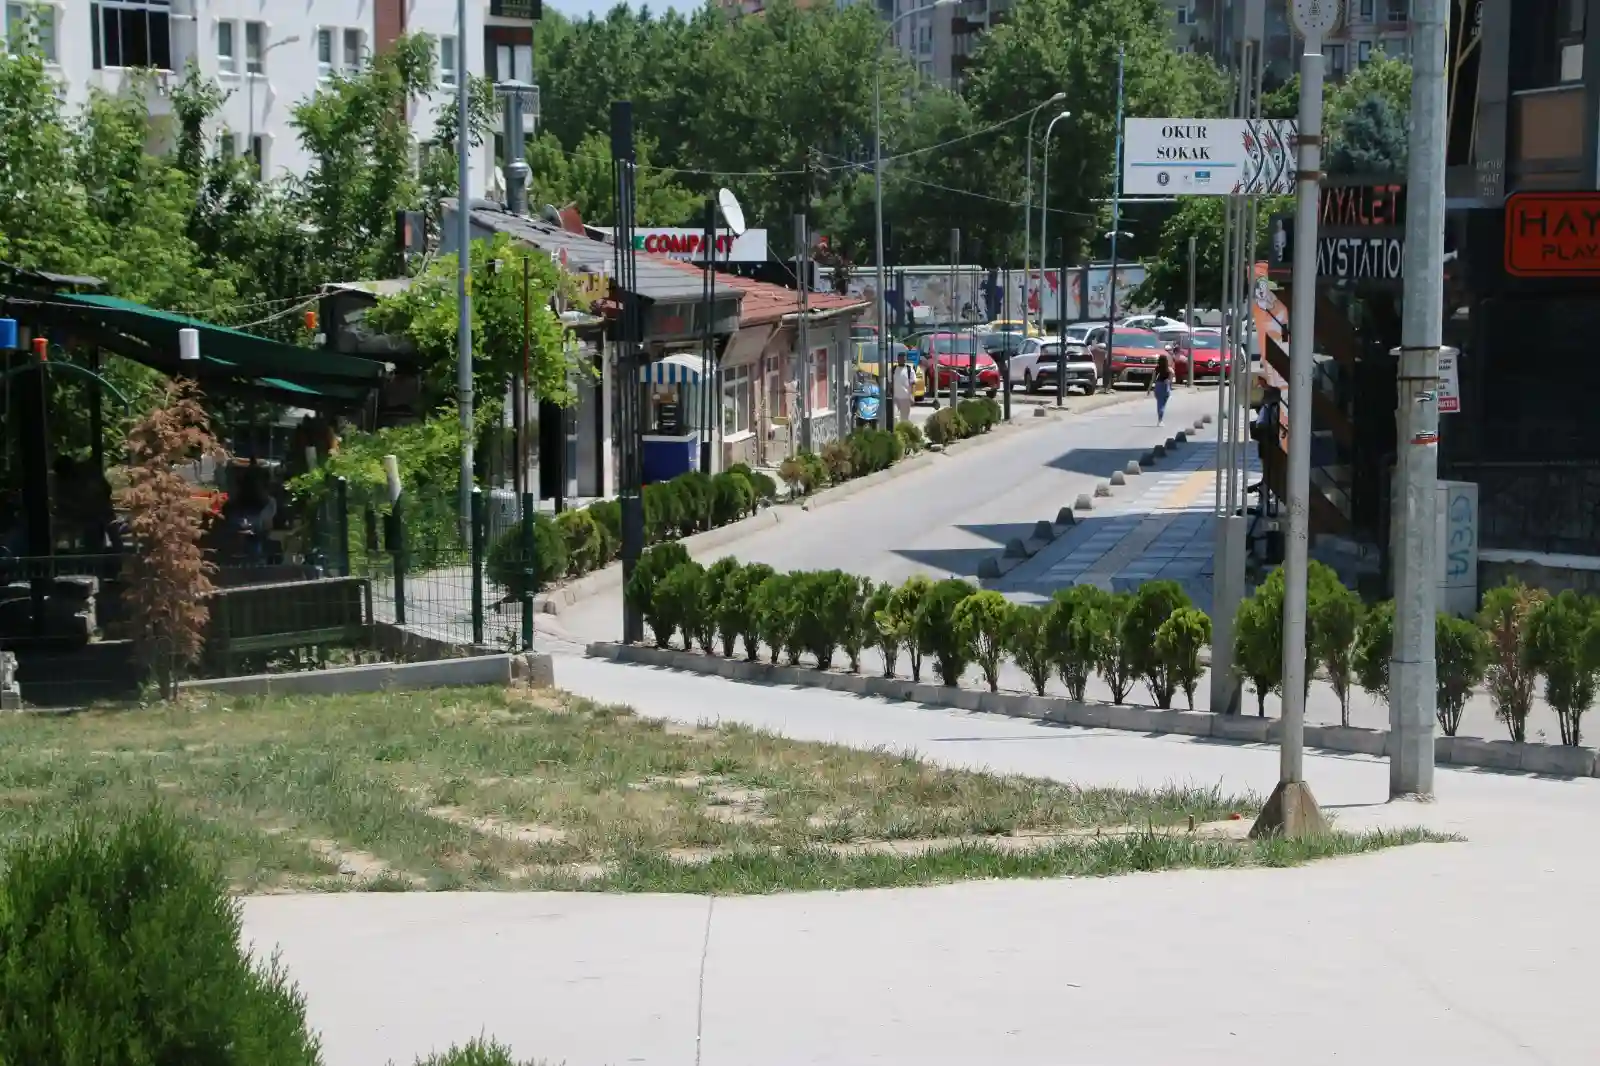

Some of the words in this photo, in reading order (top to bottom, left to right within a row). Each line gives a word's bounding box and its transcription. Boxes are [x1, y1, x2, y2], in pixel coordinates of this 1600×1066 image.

[1161, 125, 1207, 139] OKUR
[1156, 146, 1211, 160] SOKAK
[1316, 184, 1401, 227] AYALET
[1315, 237, 1406, 279] AYSTATIO
[1541, 244, 1598, 261] PLAY
